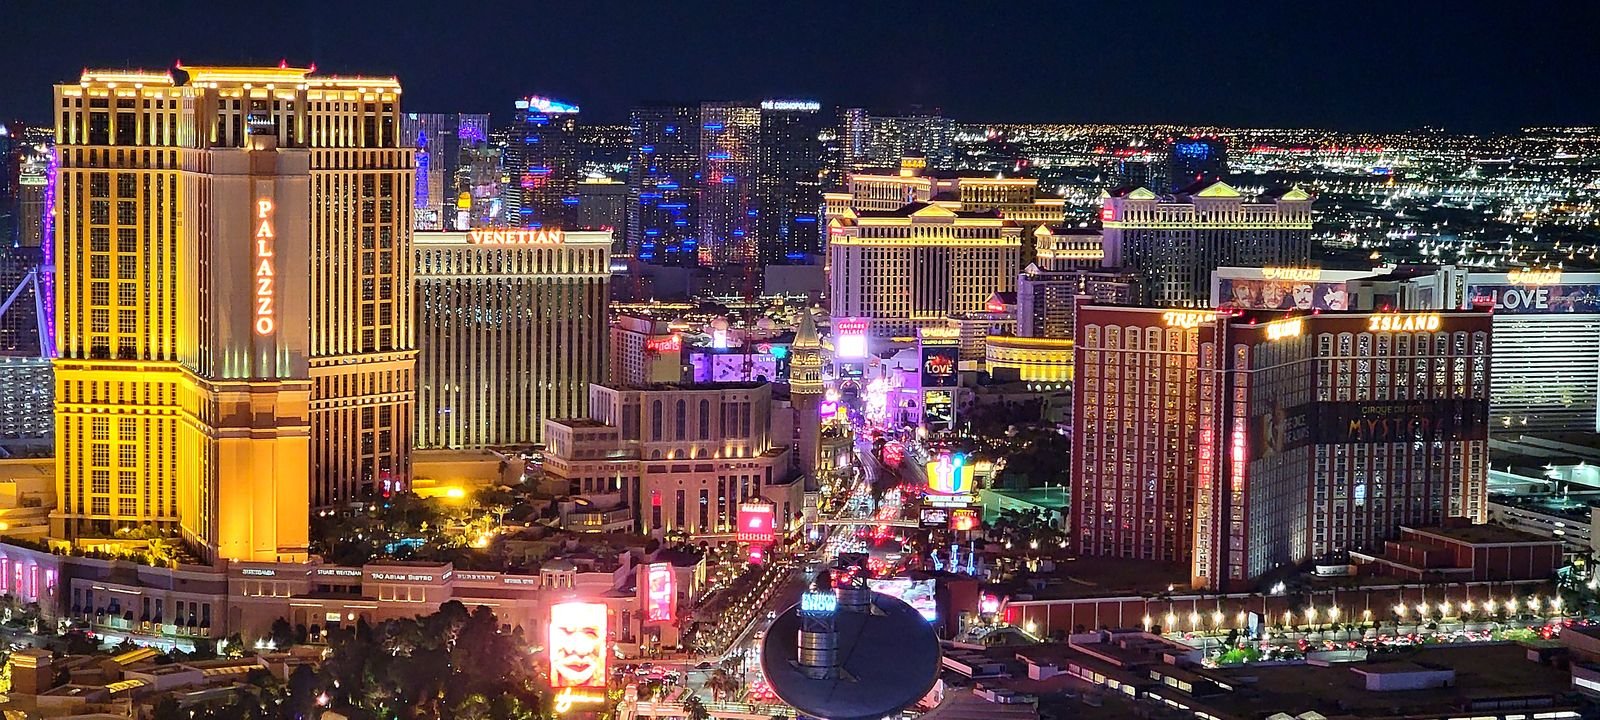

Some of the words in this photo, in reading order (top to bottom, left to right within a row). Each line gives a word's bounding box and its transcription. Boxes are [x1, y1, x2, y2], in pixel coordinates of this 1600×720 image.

[761, 101, 774, 110] THE
[775, 101, 820, 110] COSMOPOLITAN
[471, 230, 562, 244] VENETIAN
[257, 200, 273, 334] PALAZZO
[1493, 289, 1549, 309] LOVE
[1369, 315, 1438, 331] ISLAND
[926, 364, 953, 374] LOVE
[1361, 406, 1393, 415] CIRQUE
[935, 453, 965, 493] ti
[802, 592, 836, 601] FASHION
[801, 600, 836, 611] SHOW
